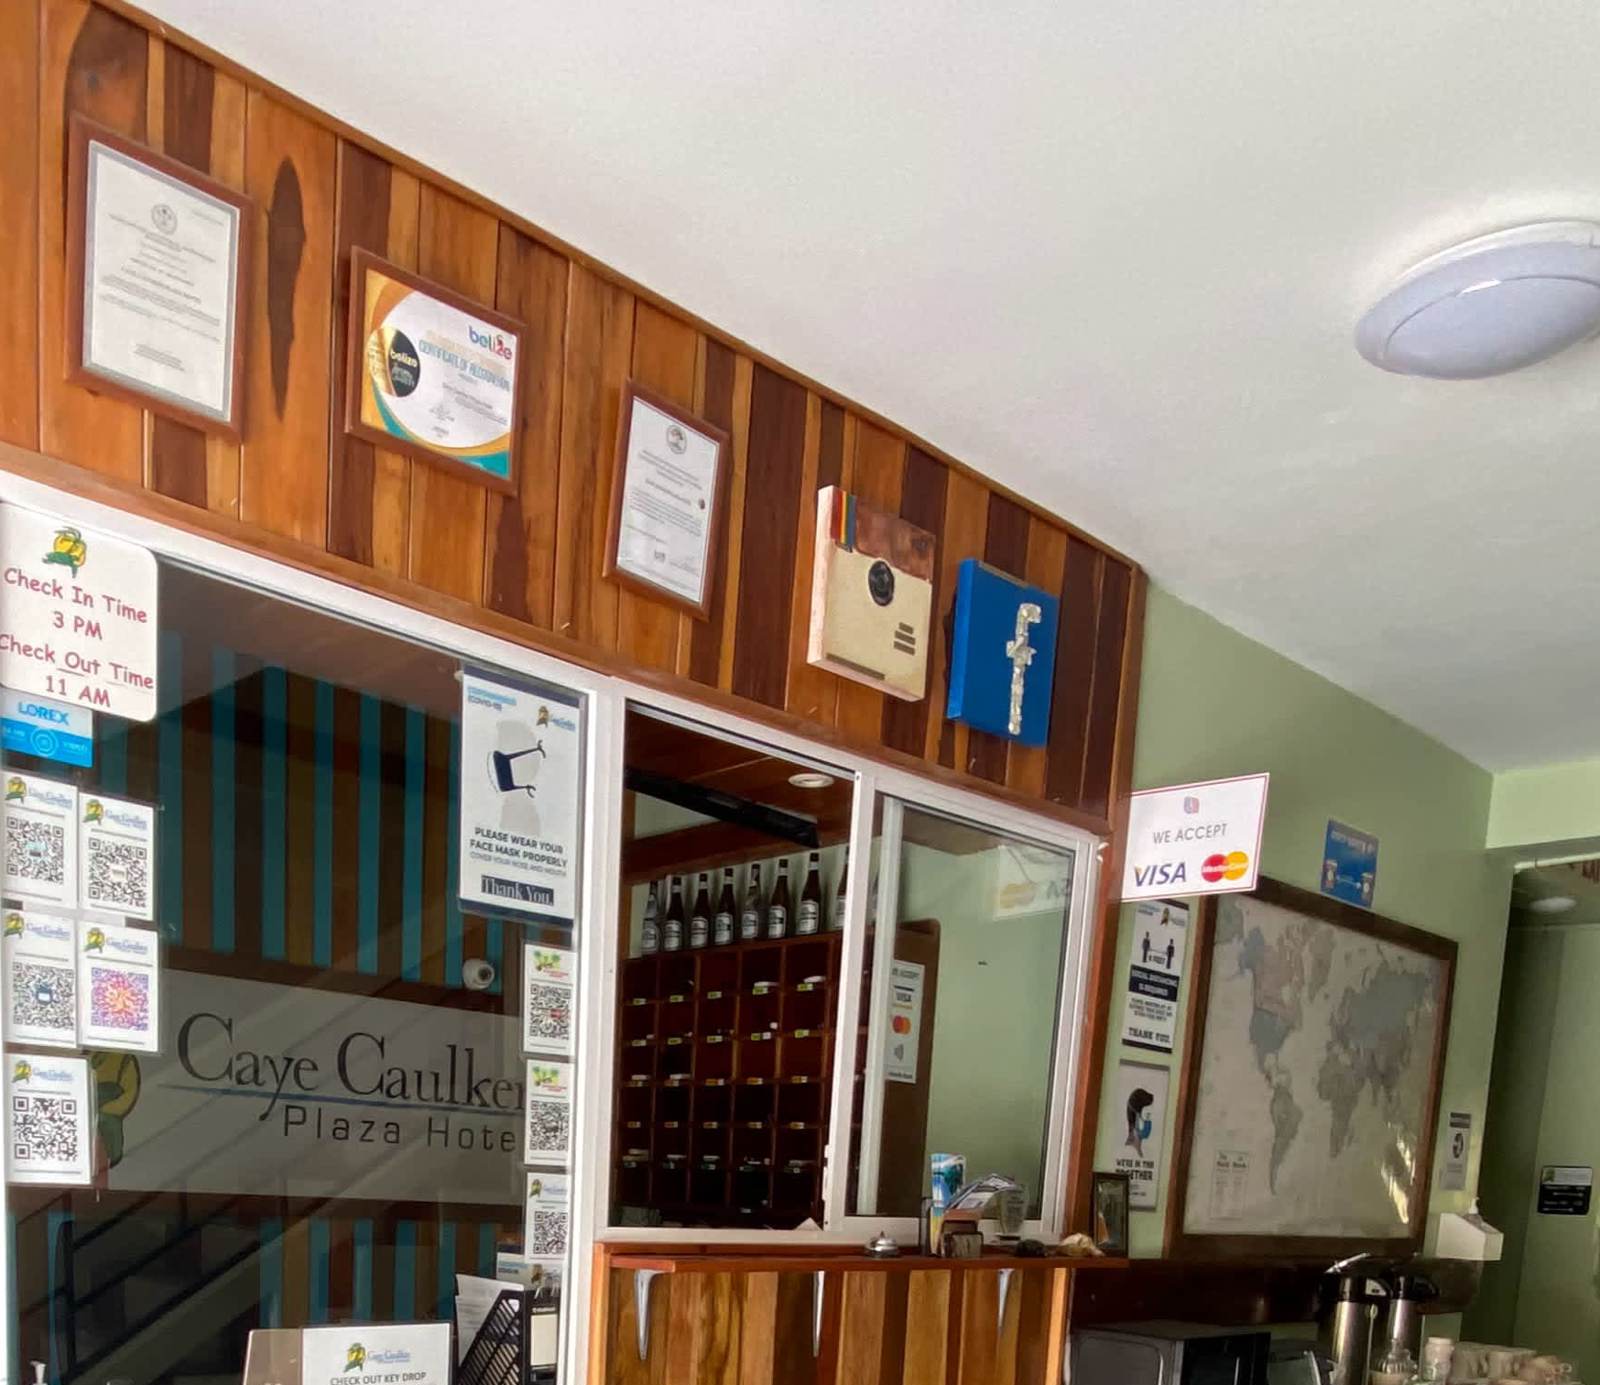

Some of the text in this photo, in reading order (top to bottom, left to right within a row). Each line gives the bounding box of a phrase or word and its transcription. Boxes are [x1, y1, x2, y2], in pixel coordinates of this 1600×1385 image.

[4, 567, 148, 623] Check In Time
[53, 611, 103, 640] 3 PM
[0, 634, 154, 689] Check Out Time
[45, 676, 111, 708] 11 AM
[18, 702, 69, 725] LOREX
[475, 827, 563, 854] PLEASE WEAR YOUR
[1153, 824, 1228, 844] WE ACCEPT
[470, 839, 568, 867] FACE MASK PROPERLY
[1134, 862, 1187, 887] VISA
[482, 878, 523, 900] Thank
[1128, 1026, 1153, 1041] THANK
[177, 1012, 319, 1121] Caye
[284, 1104, 516, 1152] Plaza Hote
[330, 1371, 426, 1385] CHECK OUT KEY DROP
